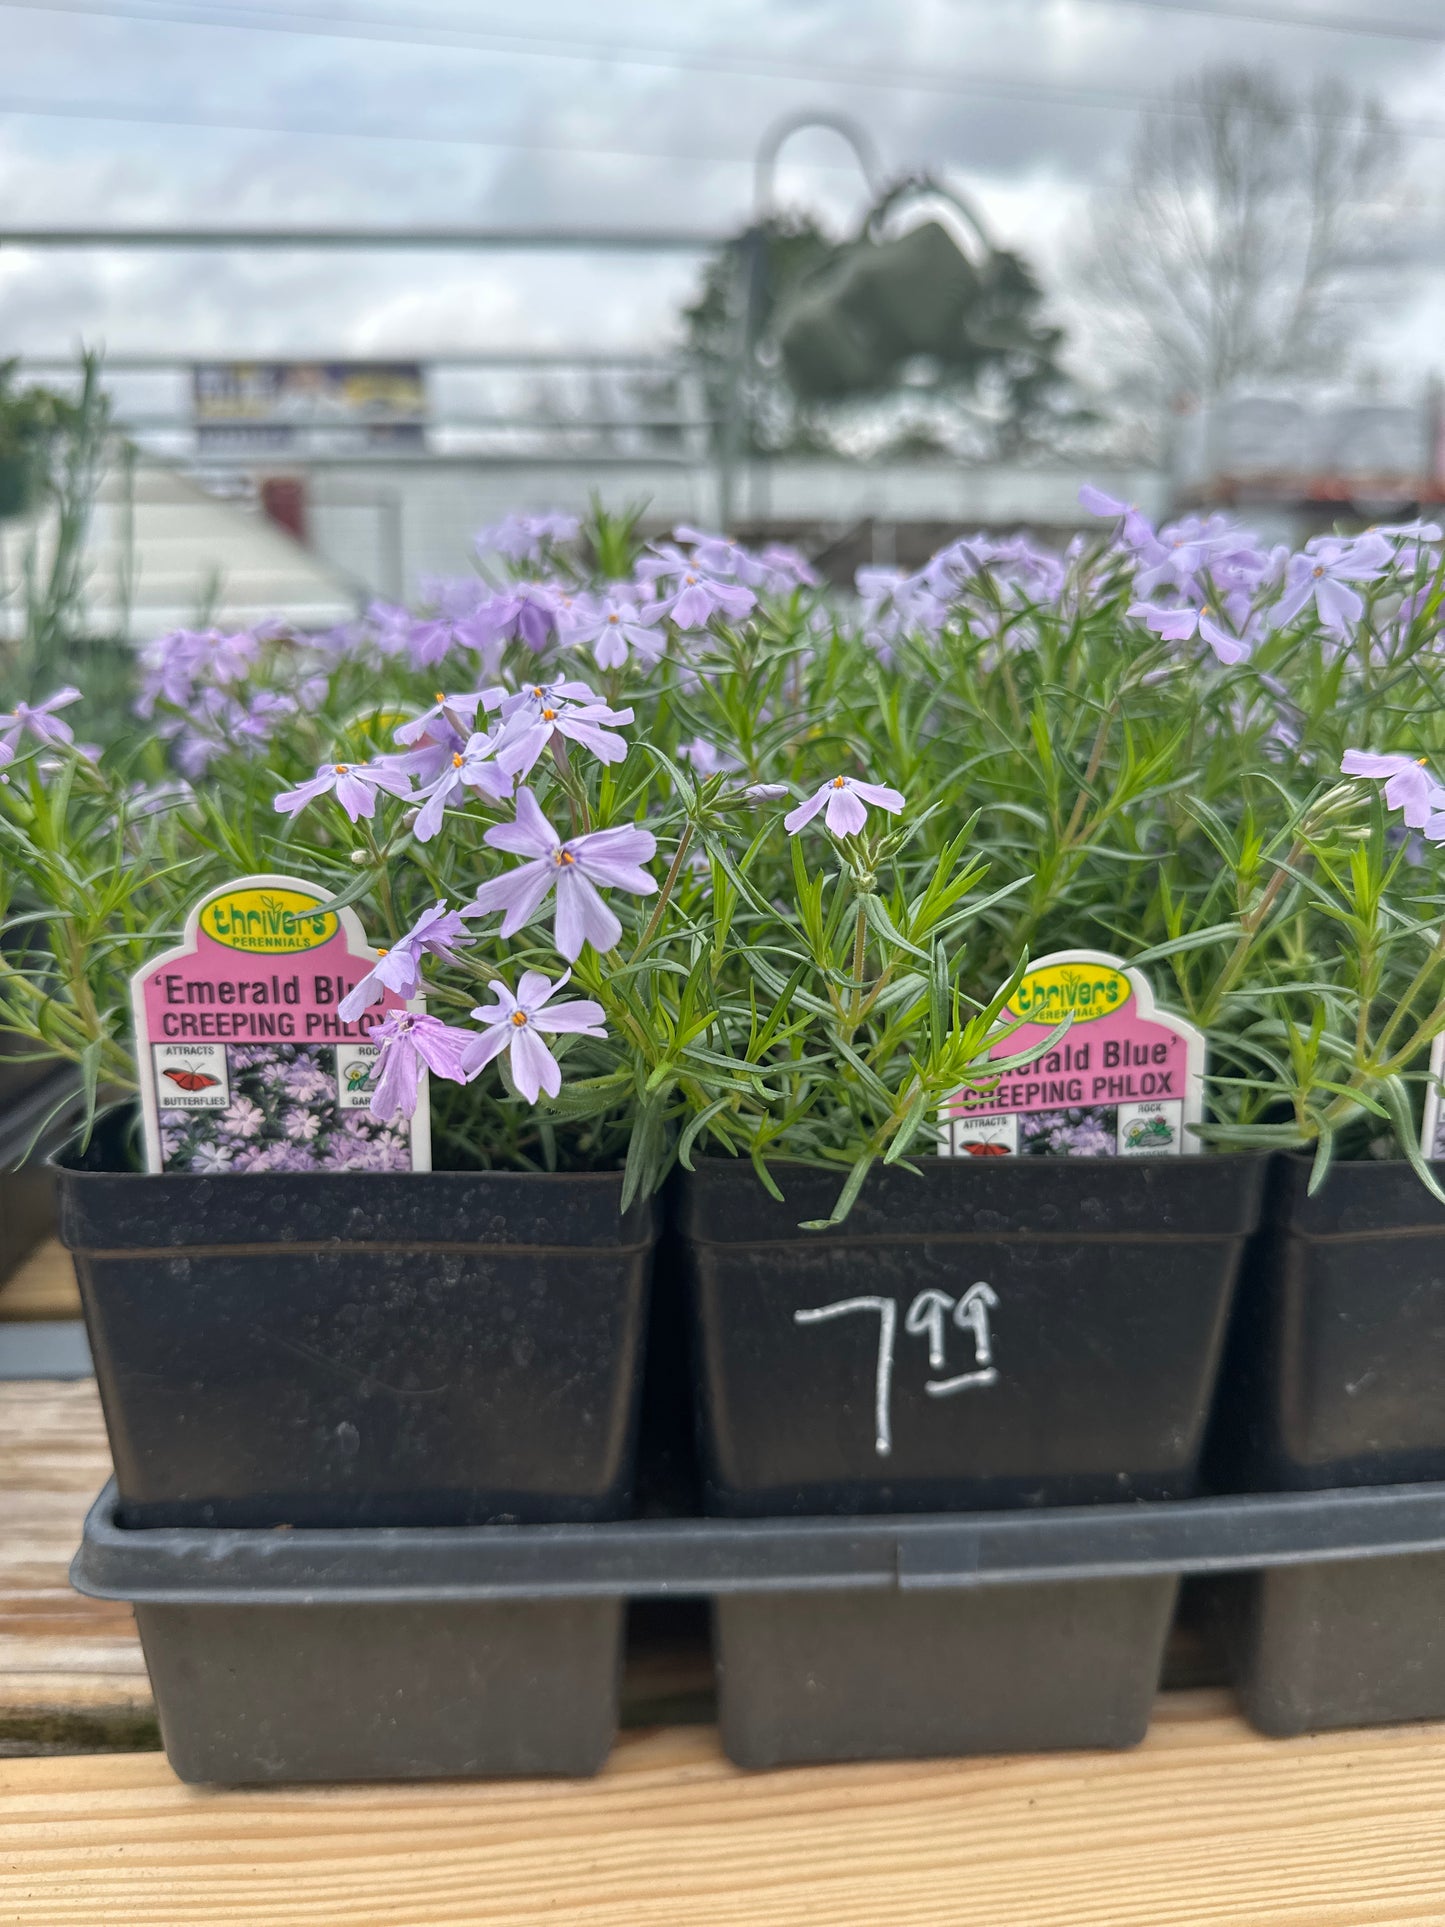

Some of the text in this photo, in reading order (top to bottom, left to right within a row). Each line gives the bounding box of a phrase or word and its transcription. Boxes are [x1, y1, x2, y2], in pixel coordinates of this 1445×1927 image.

[213, 903, 326, 935] thrivers
[232, 937, 311, 947] PERENNIALS
[314, 976, 384, 1006] Bl
[1018, 981, 1118, 1011] thrivers
[1036, 1006, 1103, 1020] ERENIALS
[163, 1012, 295, 1038] CREEPING
[166, 1046, 215, 1056] ATTRACTS
[359, 1047, 381, 1056] ROC
[1092, 1071, 1173, 1099] PHLOX
[163, 1096, 226, 1106] BUTTERFLIES
[1138, 1103, 1162, 1113] ROCK
[963, 1117, 1007, 1129] ATTRACTS
